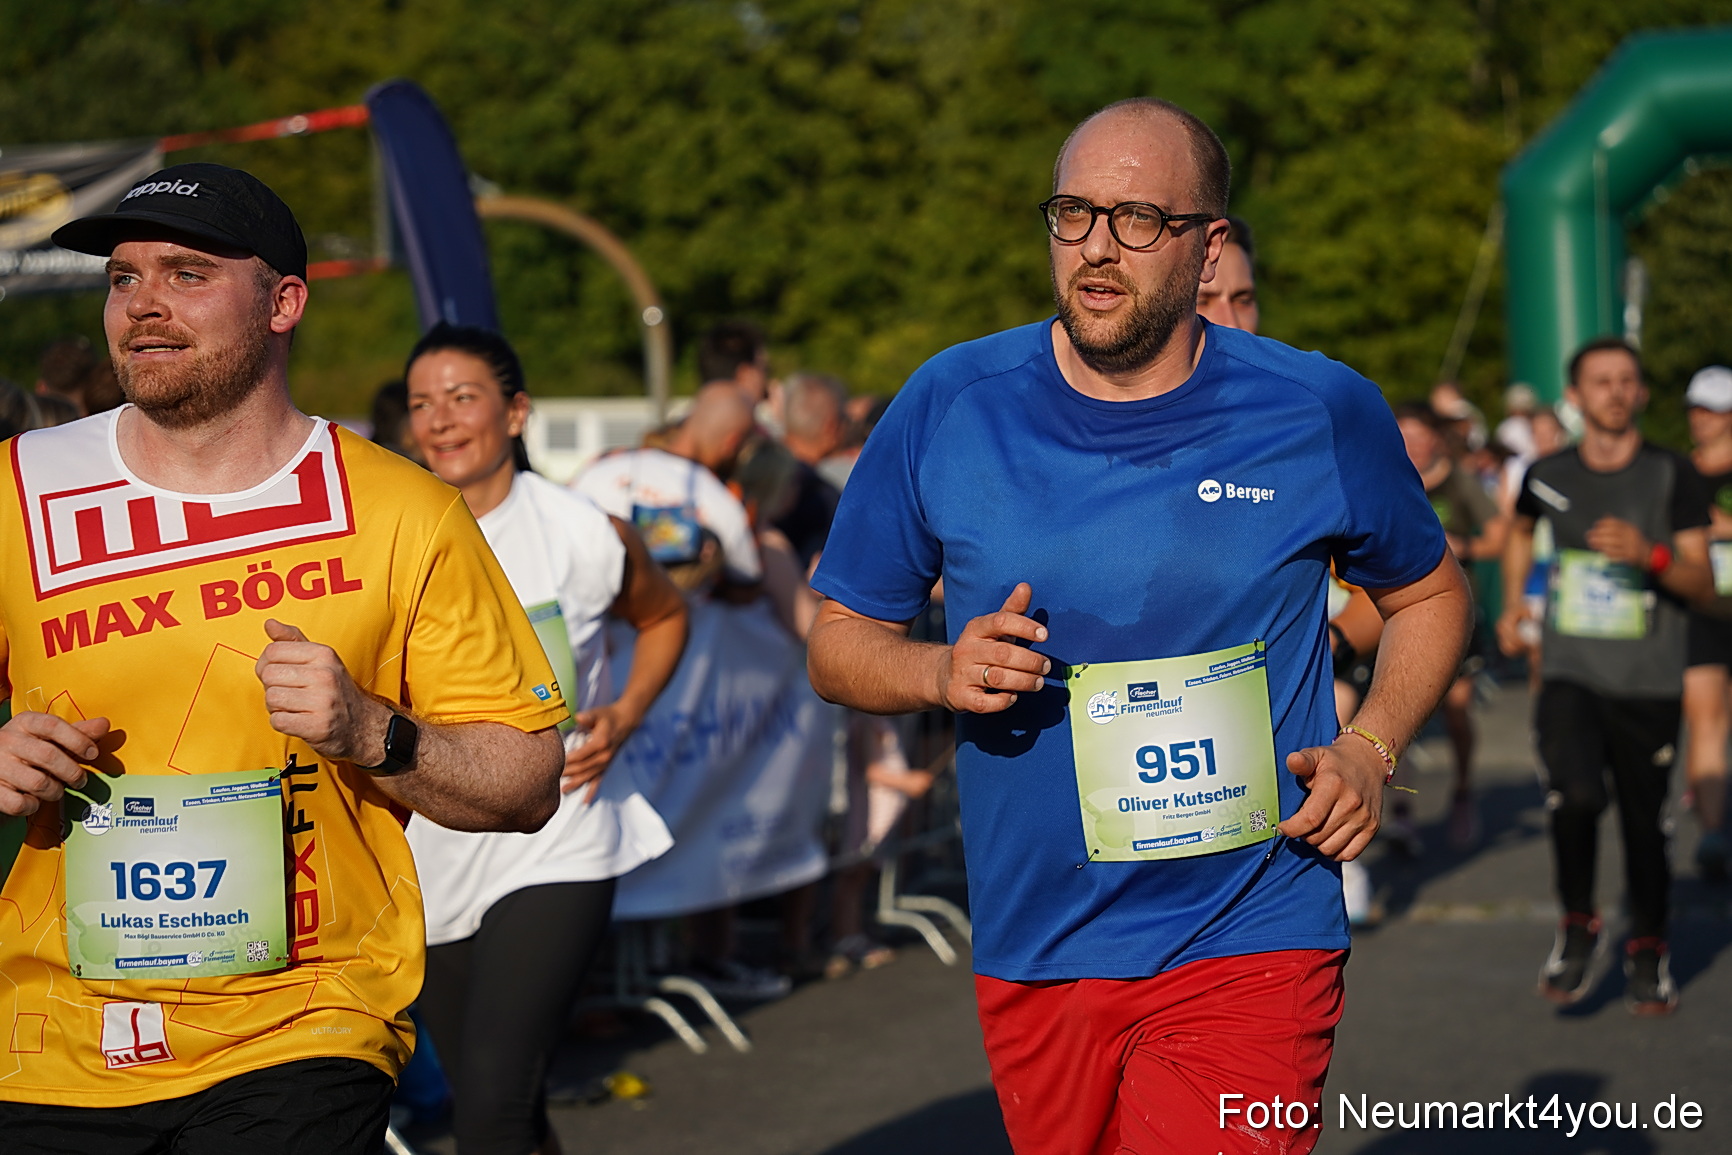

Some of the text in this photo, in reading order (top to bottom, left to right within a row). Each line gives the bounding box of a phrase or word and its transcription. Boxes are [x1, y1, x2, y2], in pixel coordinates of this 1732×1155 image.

[1225, 483, 1275, 503] Berger
[41, 556, 363, 660] MAX BÖGL
[1120, 696, 1183, 714] Firmenlauf
[1145, 706, 1183, 718] neumarkt
[1136, 737, 1217, 784] 951
[1117, 784, 1247, 812] Oliver Kutscher
[115, 815, 179, 827] Firmenlauf
[139, 825, 178, 834] neumarkt
[1136, 834, 1199, 850] firmenlauf.bayern
[110, 859, 227, 901] 1637
[100, 908, 249, 929] Lukas Eschbach
[118, 957, 184, 967] firmenlauf.bayern
[204, 953, 236, 962] Firmenlauf
[311, 1026, 352, 1035] ULTRADRY
